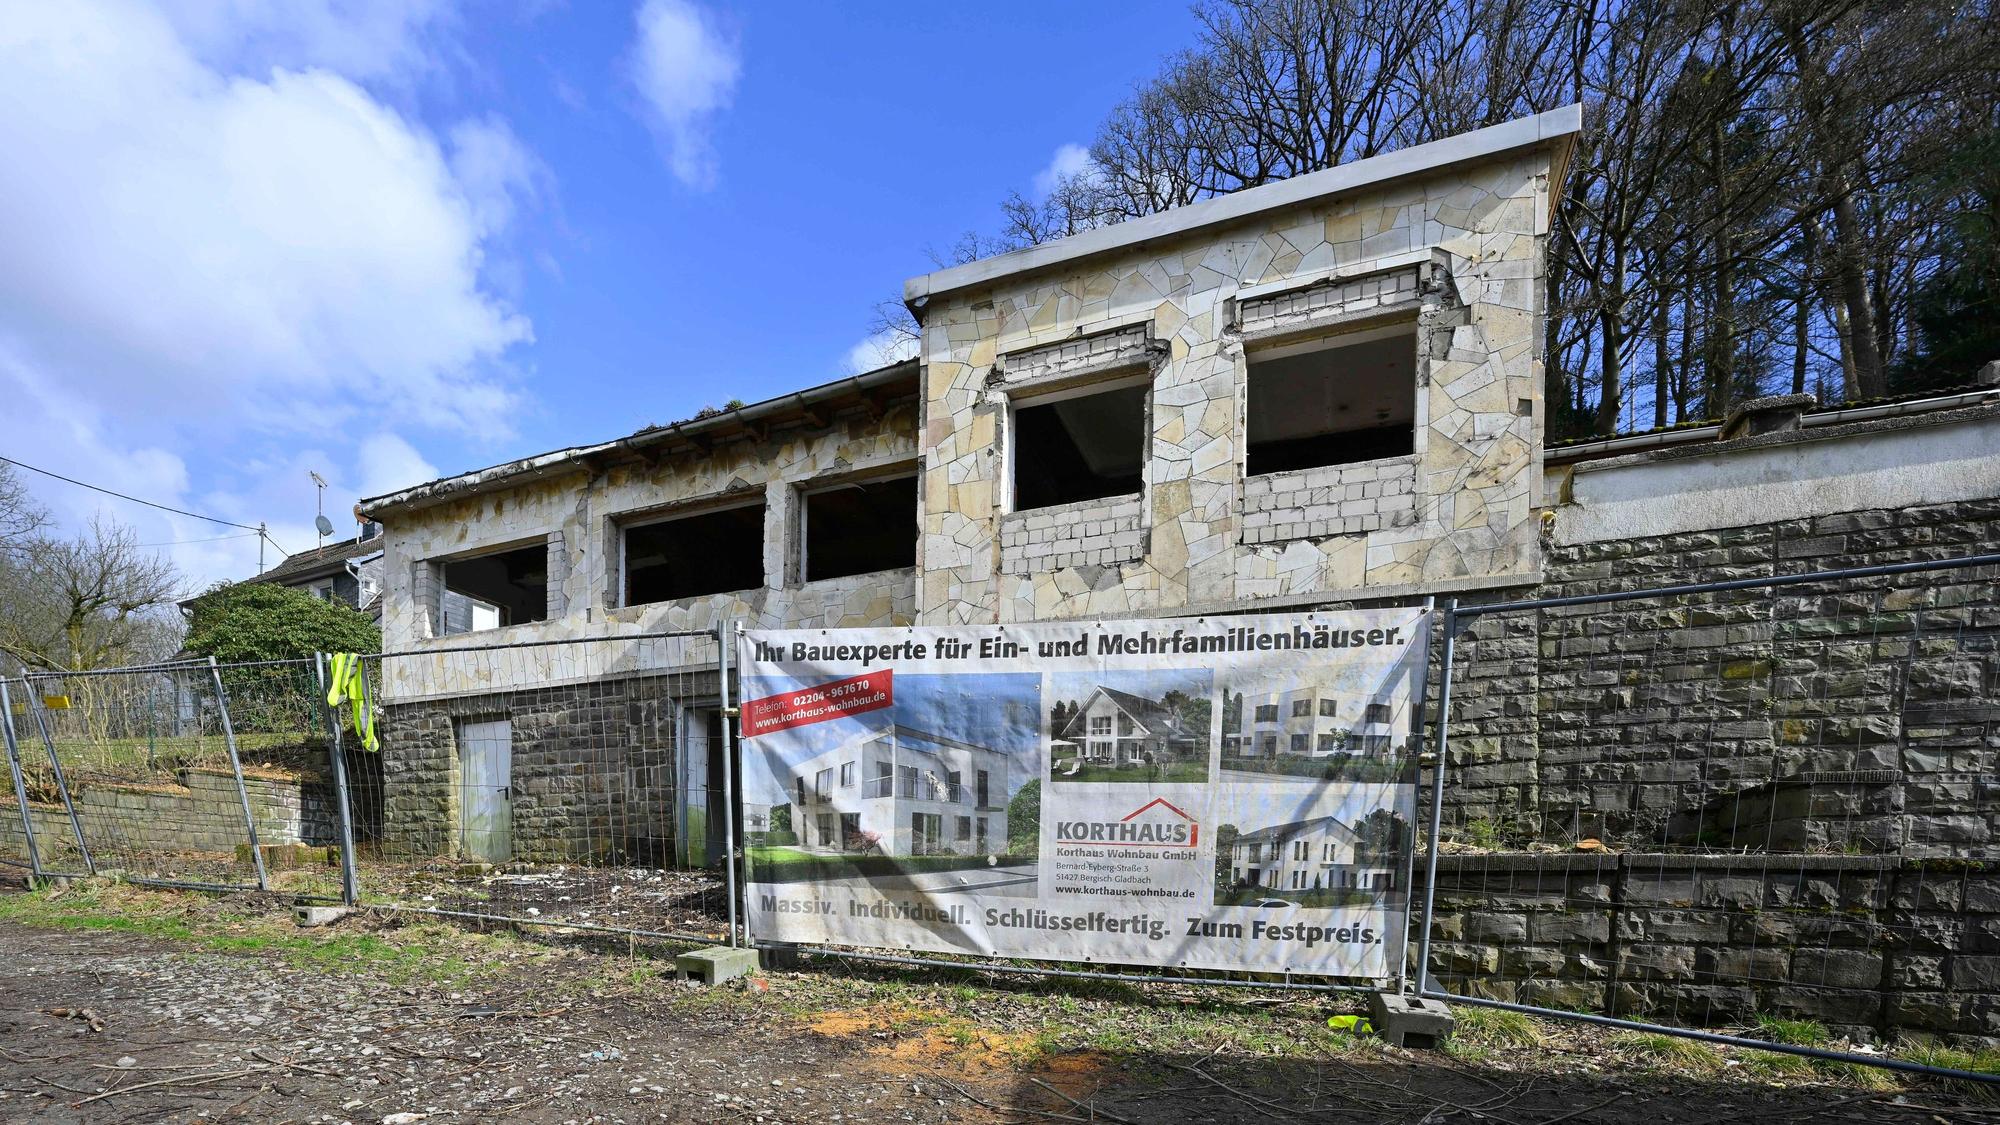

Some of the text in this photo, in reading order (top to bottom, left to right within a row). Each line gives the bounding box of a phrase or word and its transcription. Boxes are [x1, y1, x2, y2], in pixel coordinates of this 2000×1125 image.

[755, 625, 1405, 666] Ihr Bauexperte für Ein- und Mehrfamilienhäuser.
[754, 701, 787, 715] Telefon:
[755, 691, 886, 728] www.korthaus-wohnbau.de
[1057, 822, 1187, 842] KORTHAUS
[1057, 848, 1197, 861] Korthaus Wohnbau GmbH
[1056, 862, 1149, 873] Bernard-Eyberg-Straße 3
[1056, 873, 1152, 884] 51427 Bergisch Gladbach
[1056, 886, 1195, 898] www.korthaus-wohnbau.de
[761, 895, 1381, 948] Massiv. Individuell. Schlüsselfertig. Zum Festpreis.
